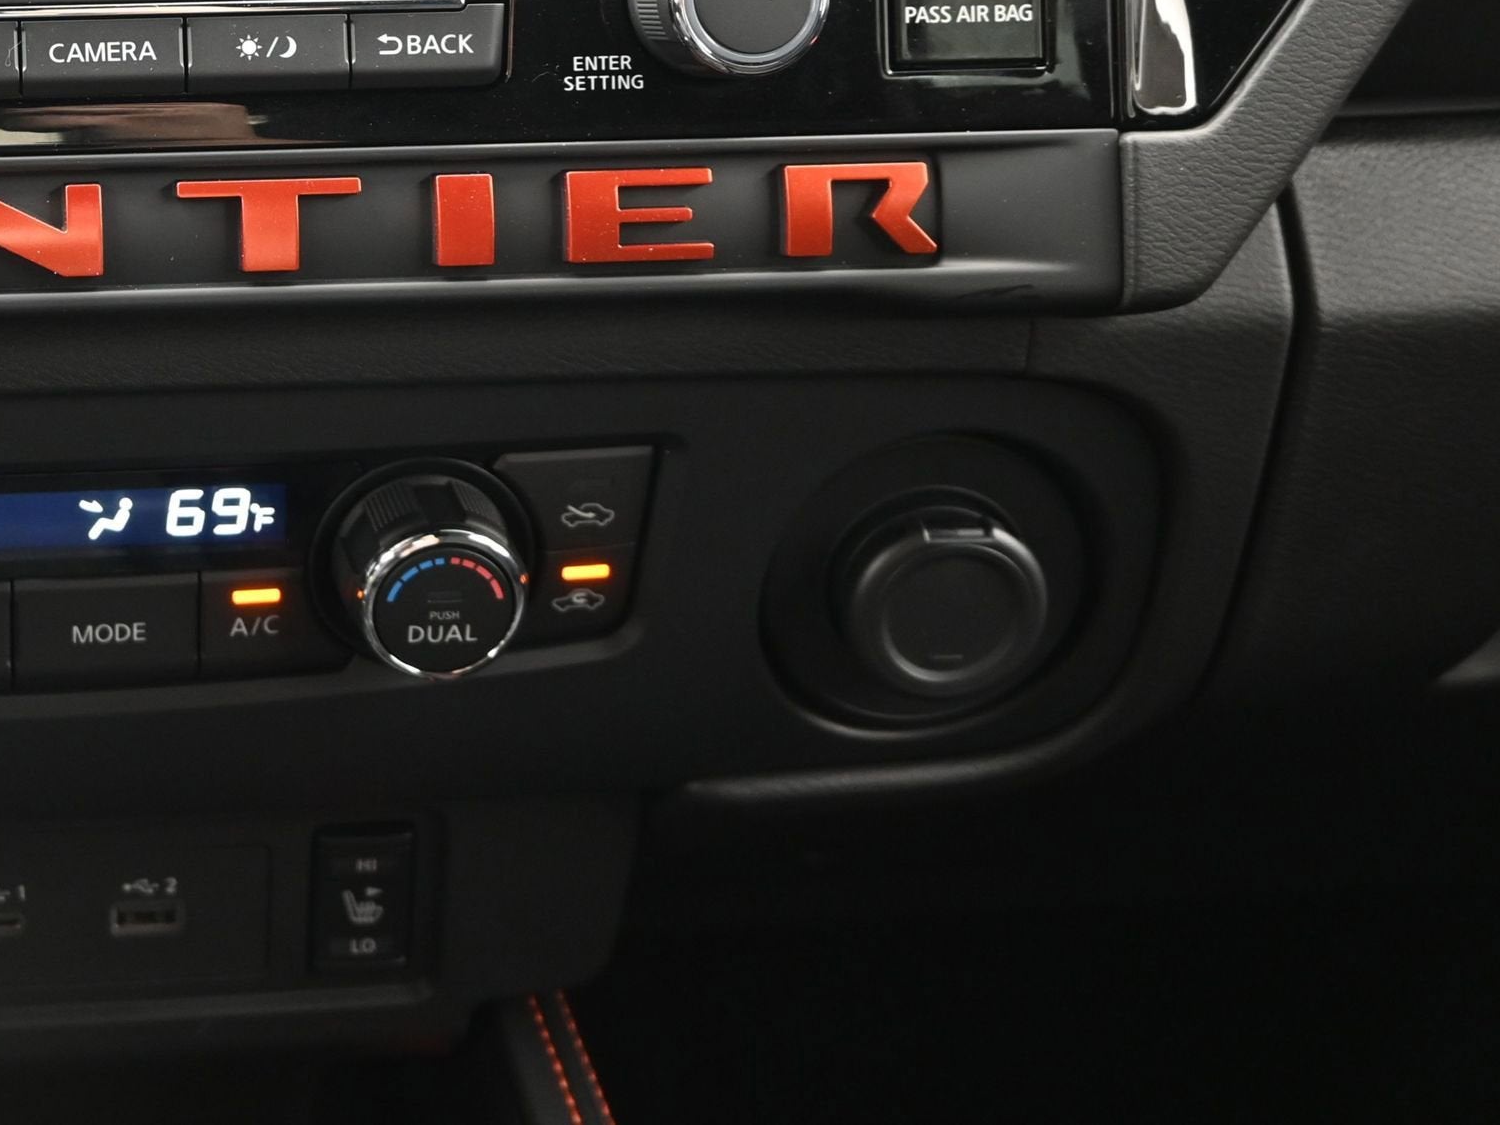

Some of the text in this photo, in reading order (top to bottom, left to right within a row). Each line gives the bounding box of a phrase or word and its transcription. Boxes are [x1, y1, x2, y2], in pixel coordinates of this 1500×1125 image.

[904, 3, 1034, 24] PASS AIR BAG
[48, 41, 157, 65] CAMERA
[406, 33, 474, 56] BACK
[572, 55, 632, 72] ENTER
[563, 74, 645, 92] SETTING
[428, 610, 461, 621] PUSH
[71, 621, 147, 646] MODE
[229, 615, 280, 639] A/C
[406, 622, 478, 645] DUAL
[356, 859, 377, 872] HI
[350, 938, 377, 954] LO
